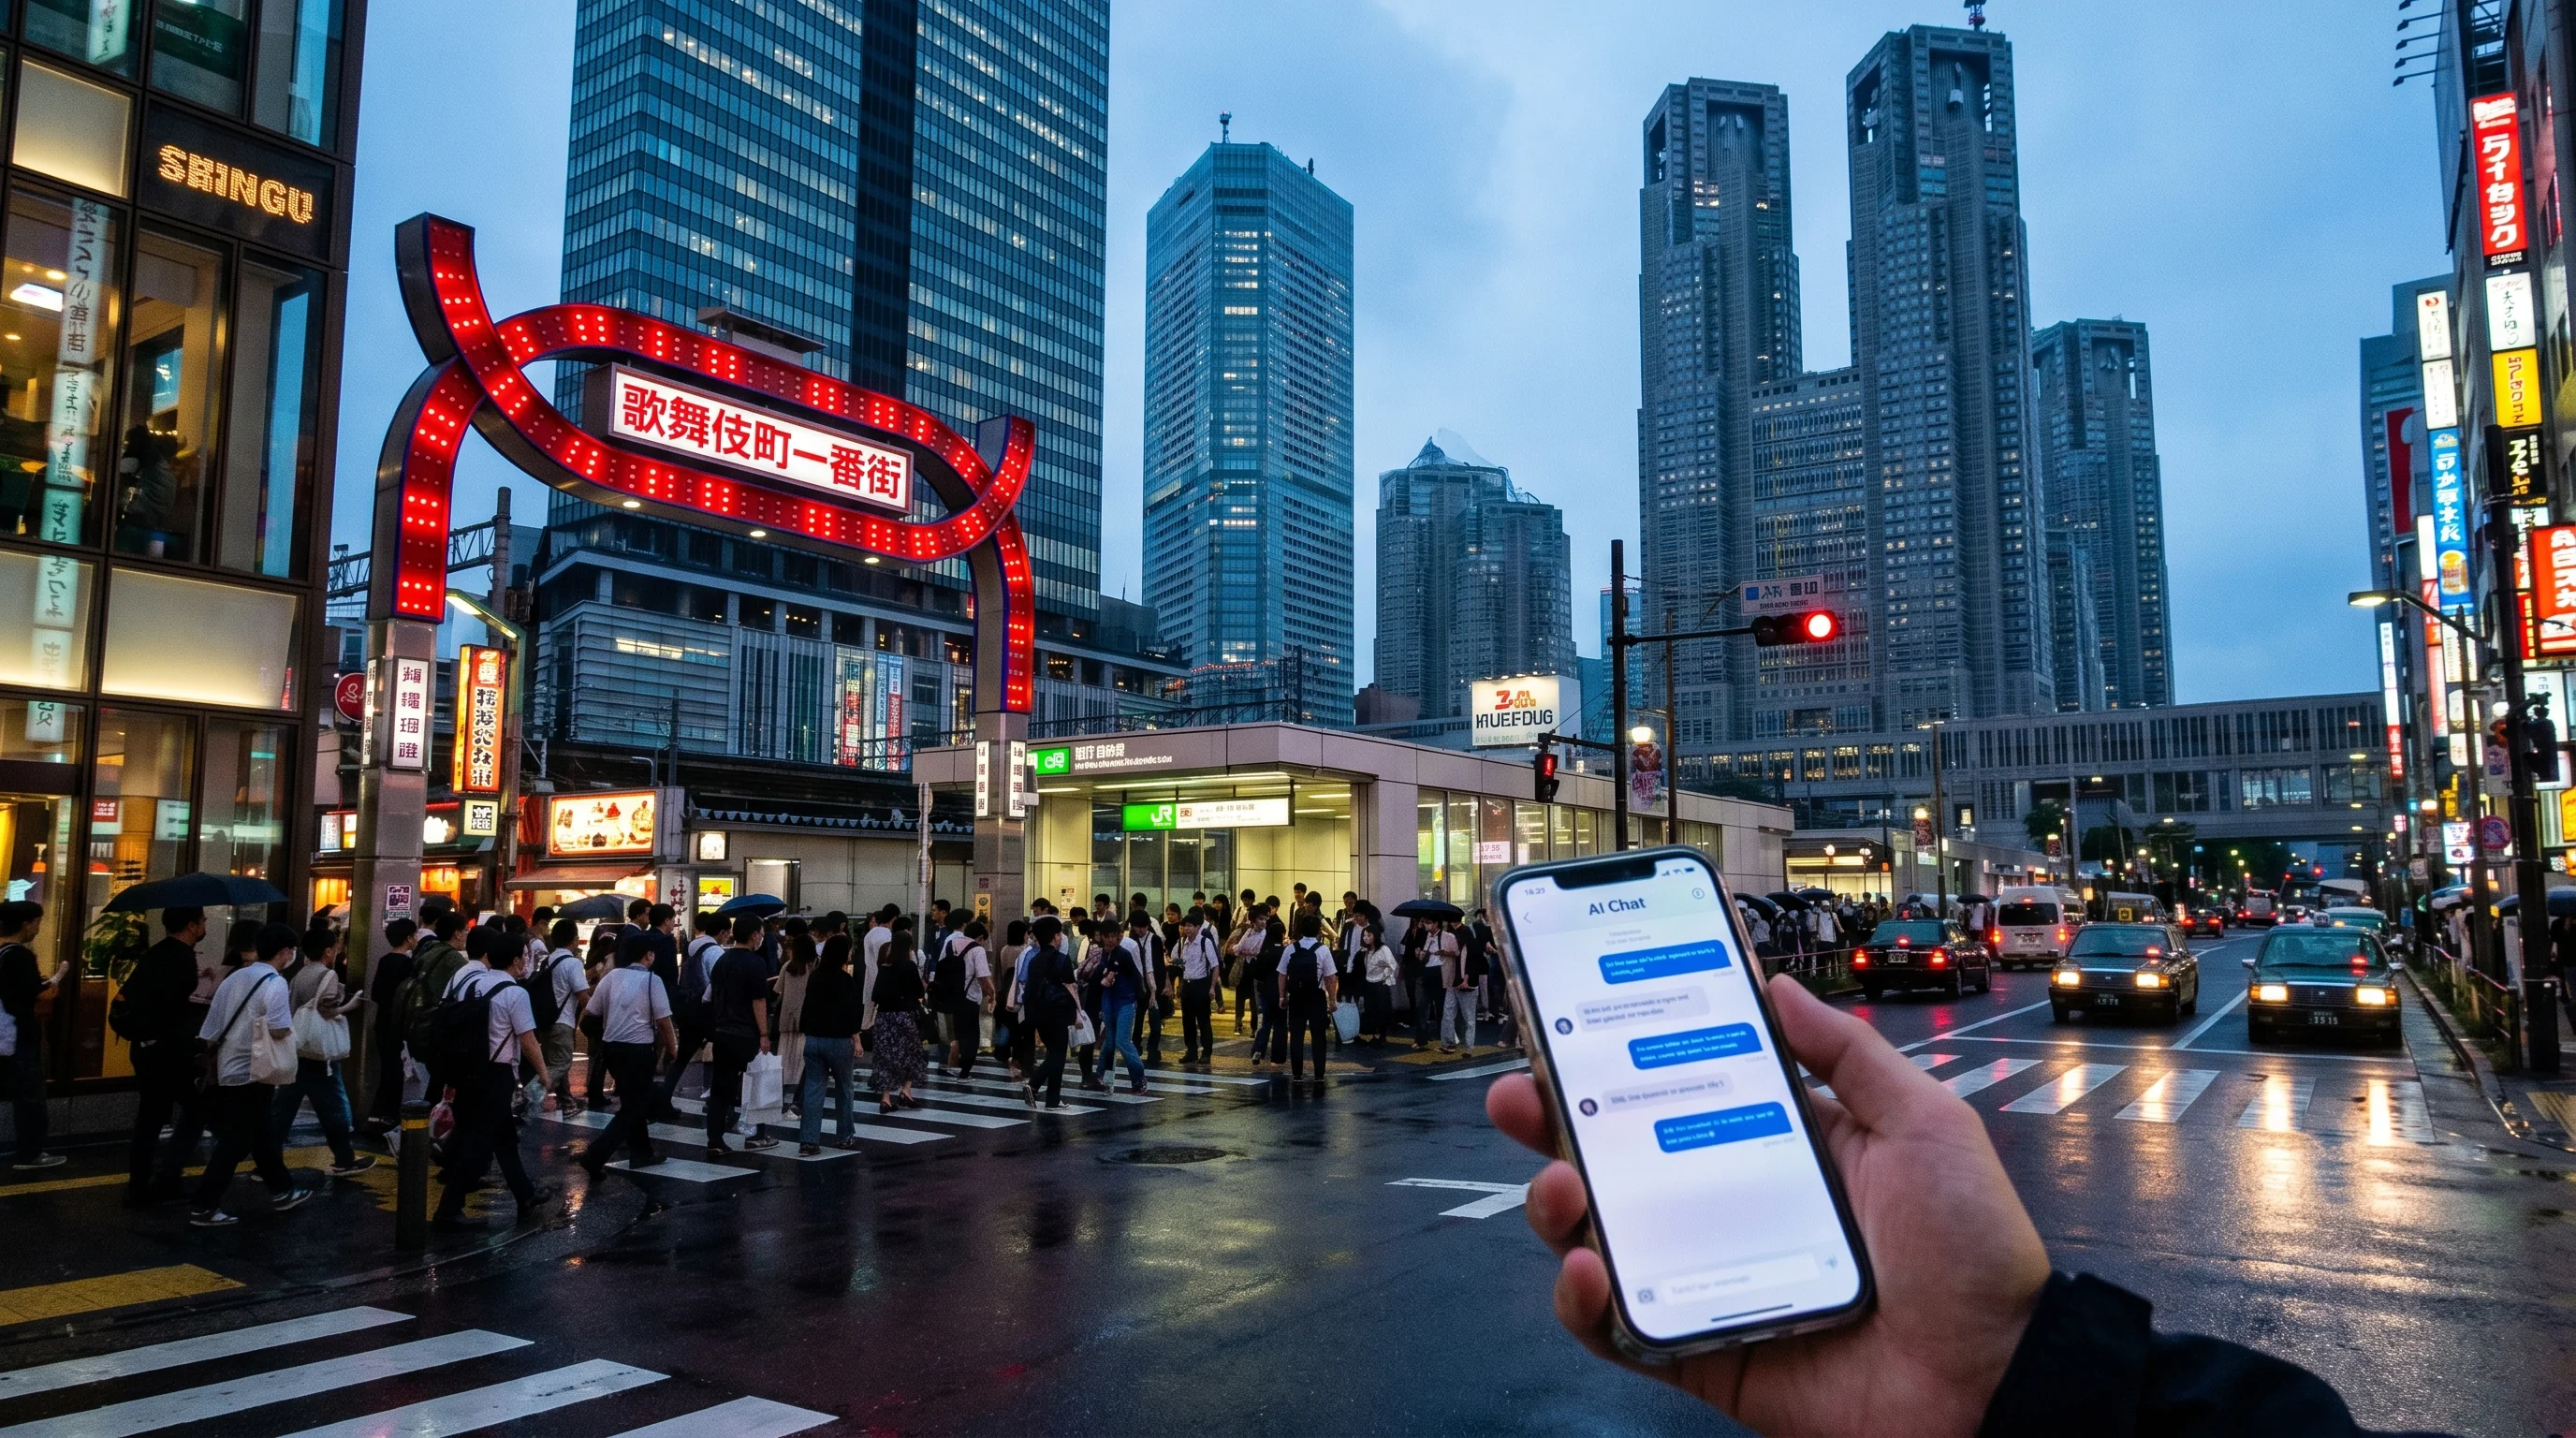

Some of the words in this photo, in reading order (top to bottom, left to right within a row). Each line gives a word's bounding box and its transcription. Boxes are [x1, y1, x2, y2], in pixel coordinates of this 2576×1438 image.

[622, 382, 901, 500] 歌舞伎町一番街
[1150, 805, 1173, 823] JR
[1588, 902, 1605, 916] AI
[1607, 897, 1647, 913] Chat
